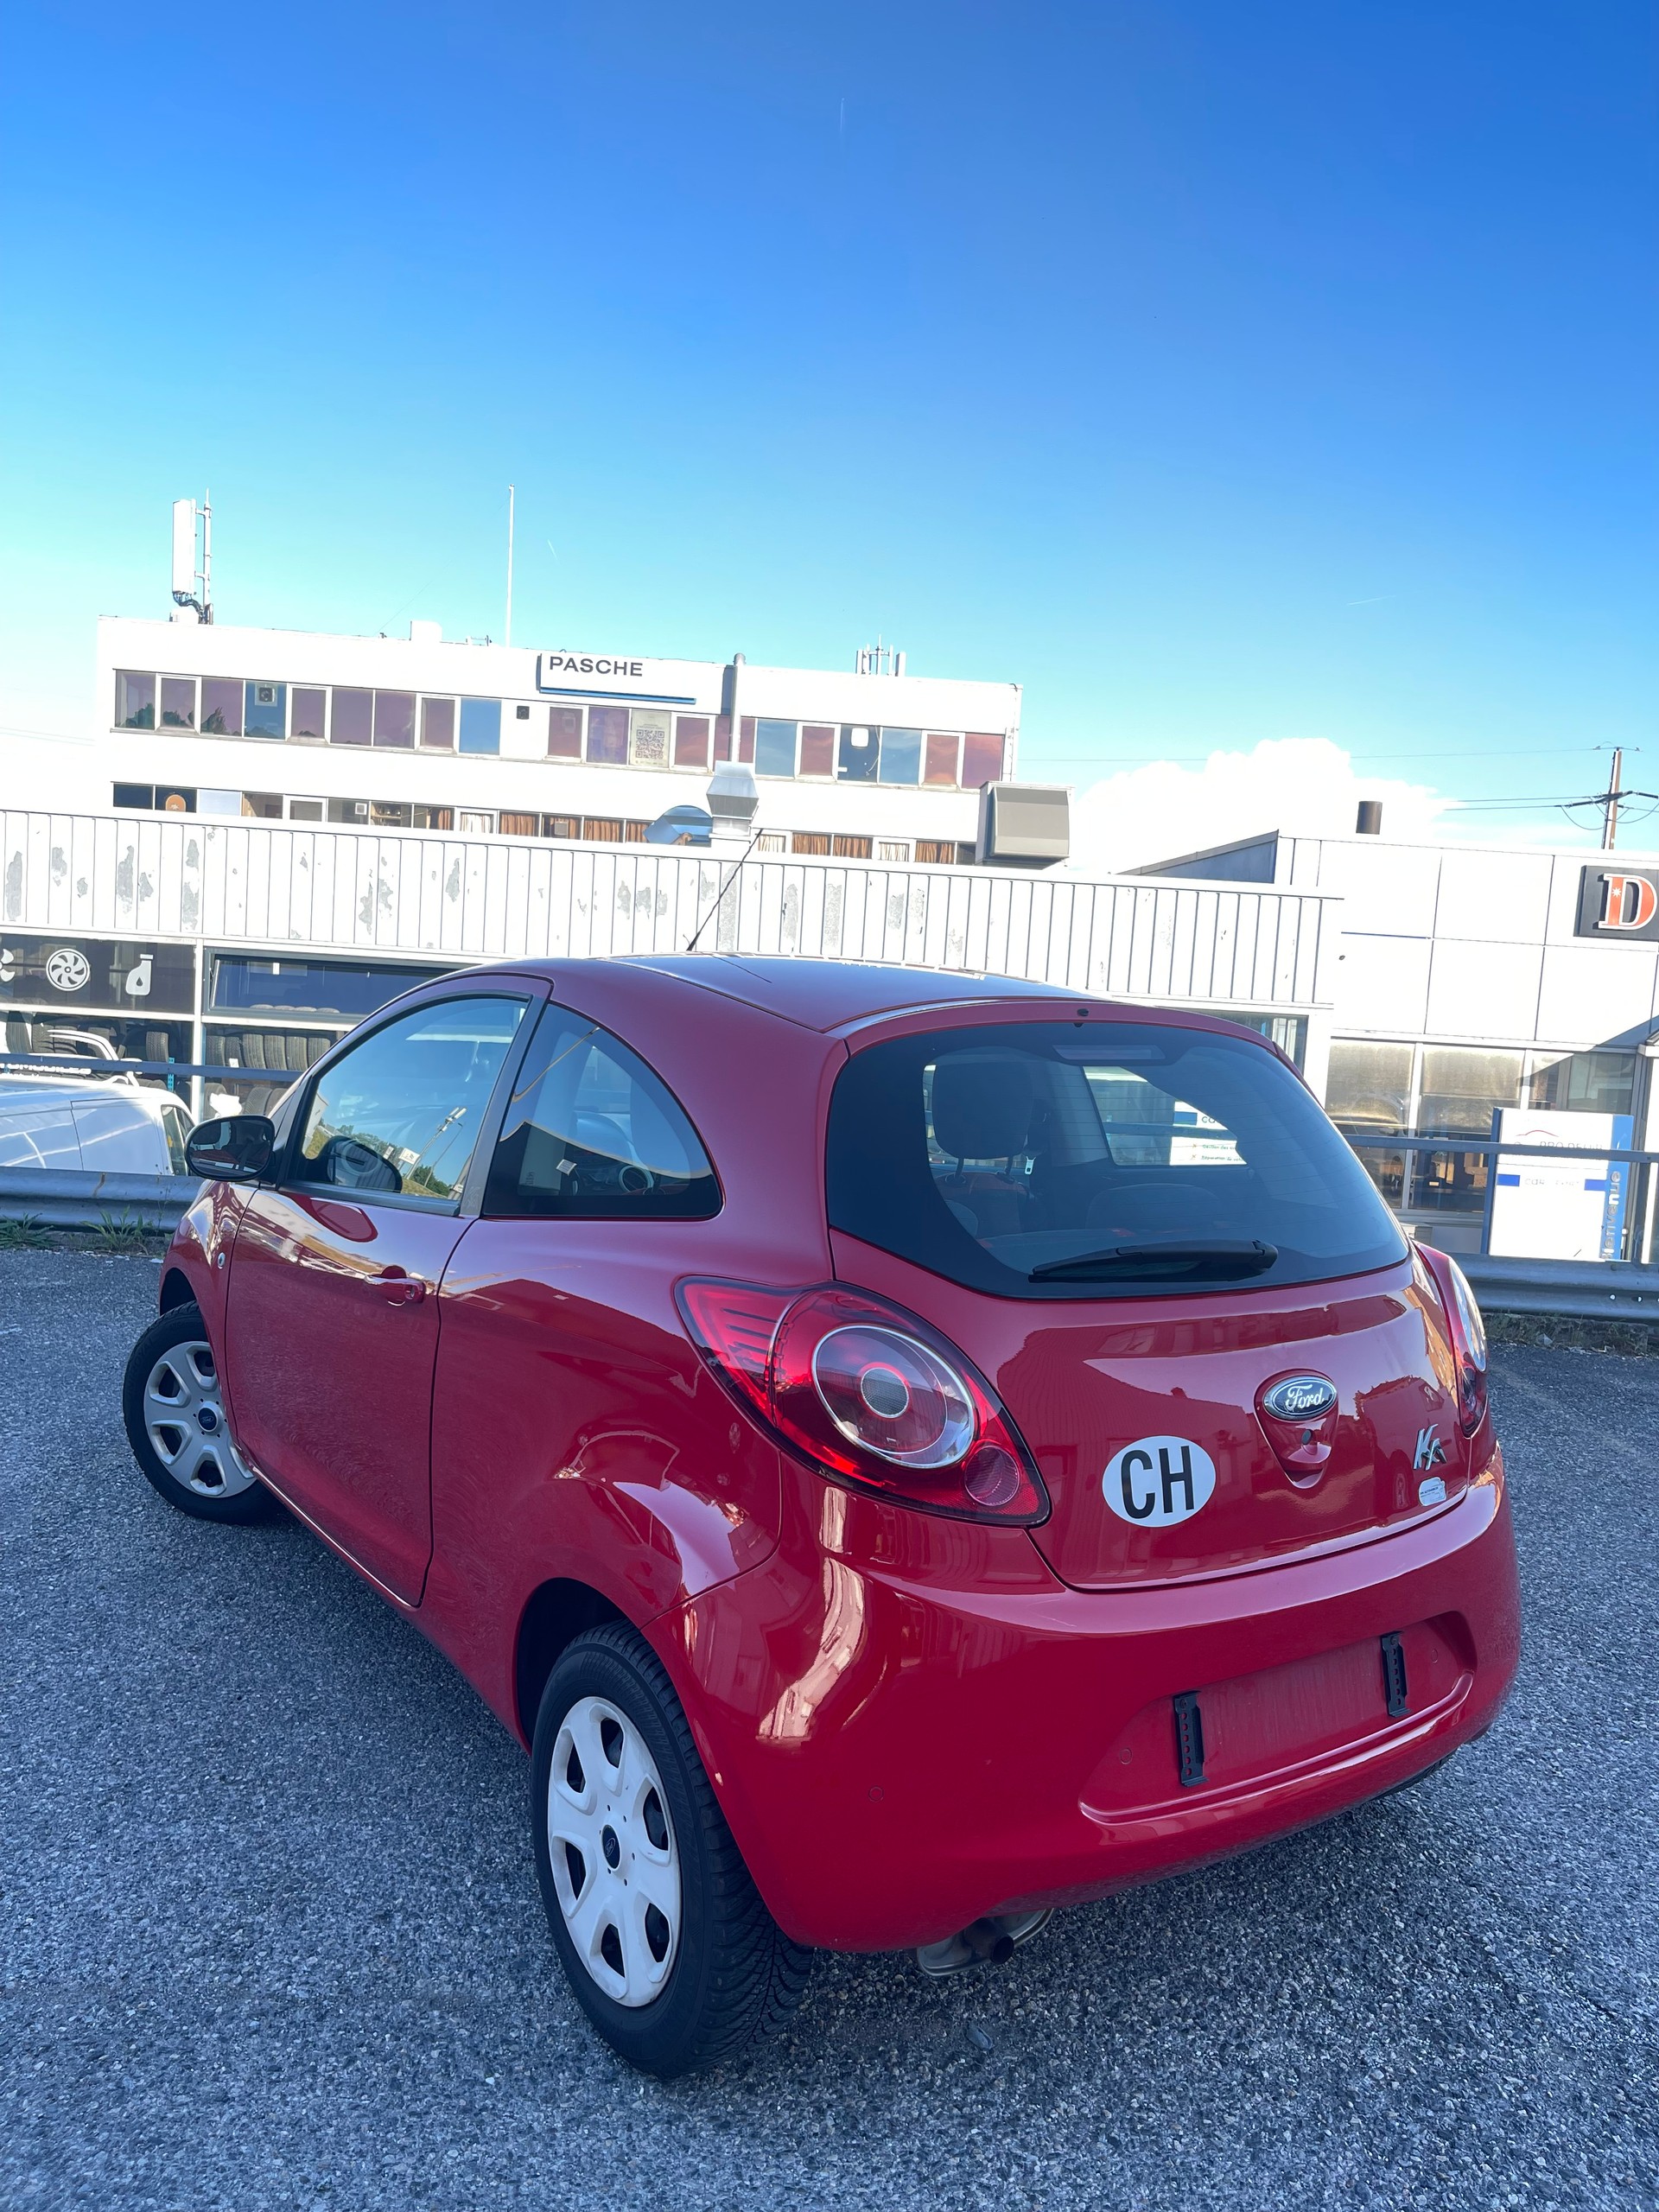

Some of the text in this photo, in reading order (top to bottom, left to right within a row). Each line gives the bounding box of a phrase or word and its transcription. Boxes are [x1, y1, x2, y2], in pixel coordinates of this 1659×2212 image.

[550, 656, 643, 677] PASCHE
[1598, 873, 1657, 931] D
[1286, 1383, 1325, 1412] Ford
[1121, 1445, 1194, 1519] CH
